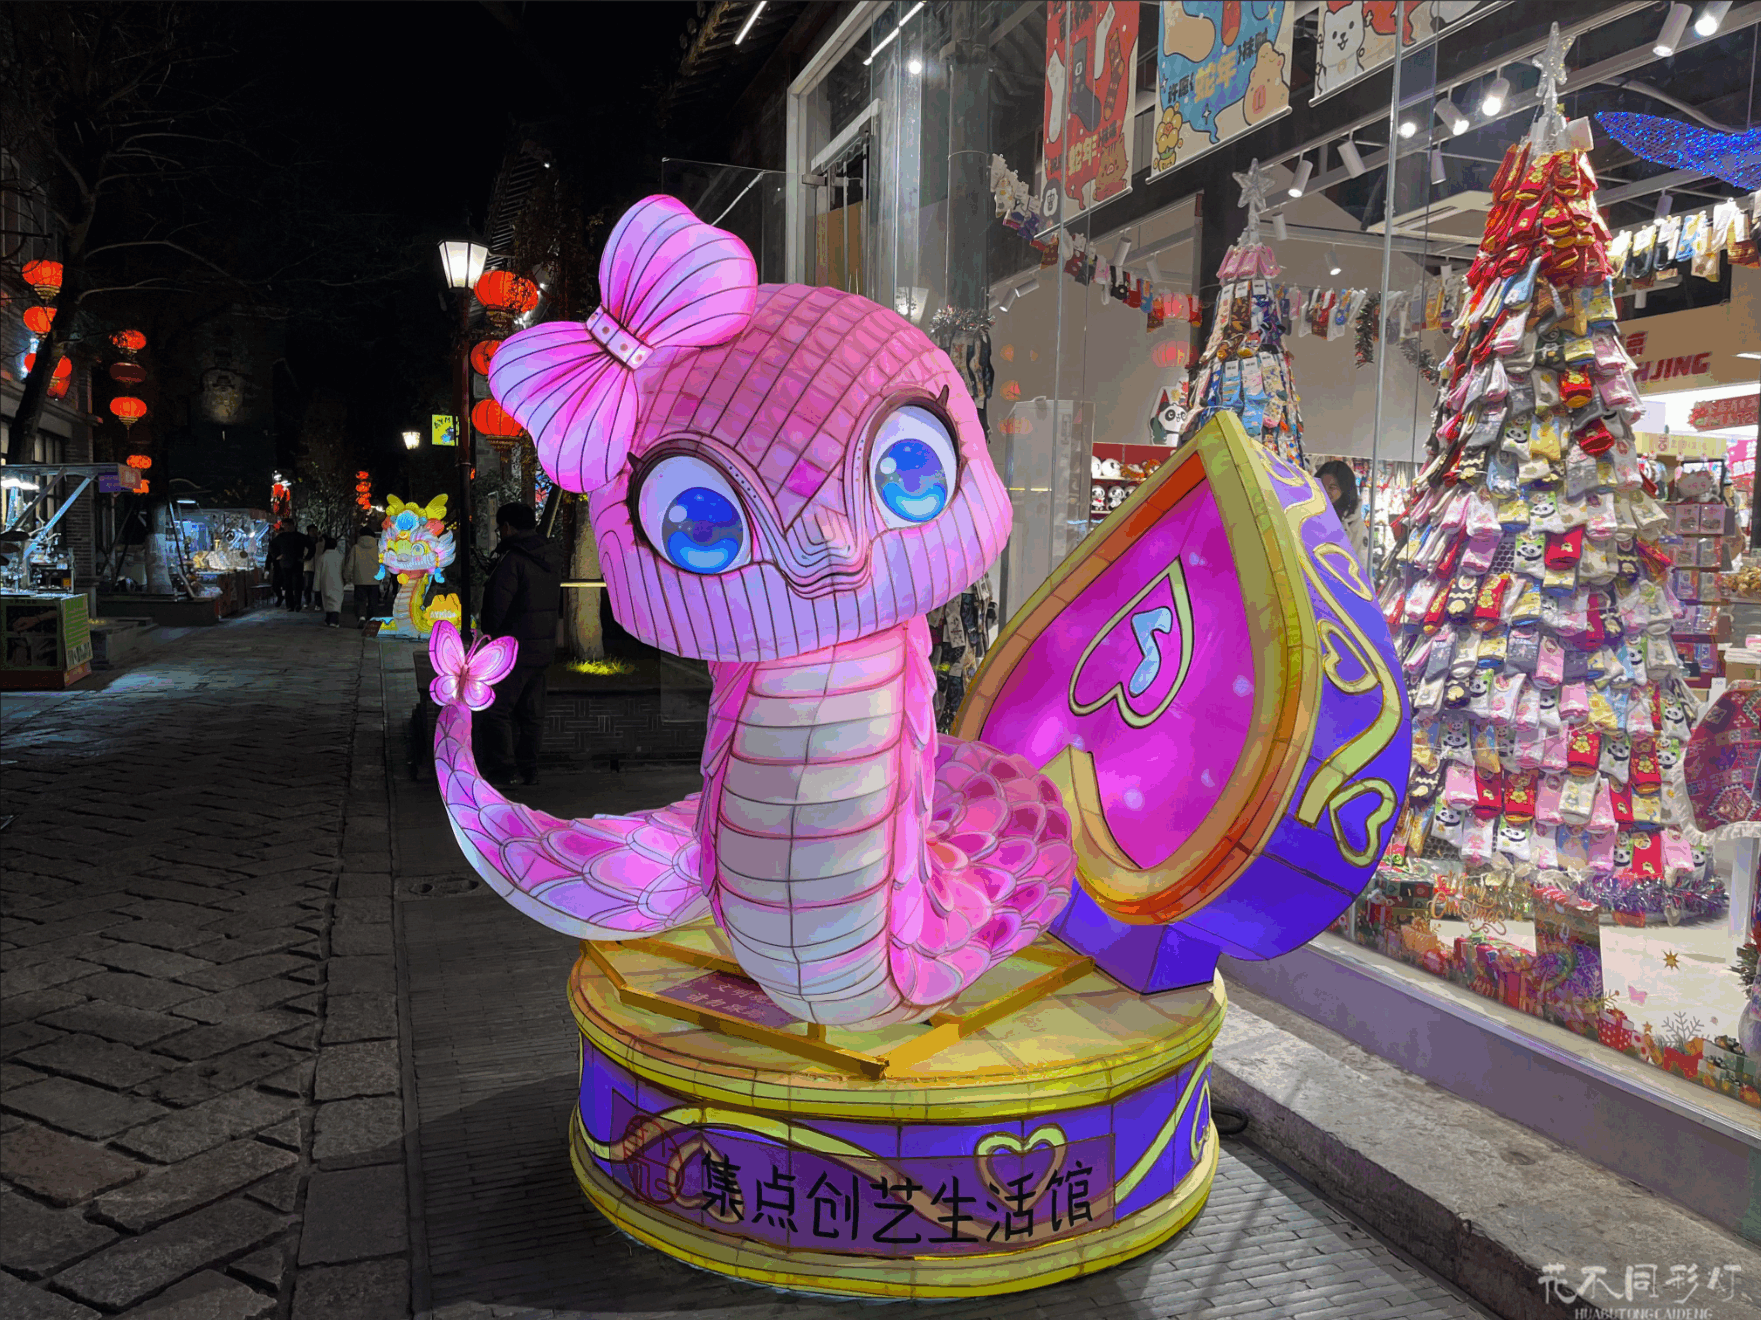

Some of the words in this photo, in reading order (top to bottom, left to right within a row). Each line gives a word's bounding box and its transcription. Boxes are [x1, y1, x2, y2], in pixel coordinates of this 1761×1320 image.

[700, 1149, 1094, 1245] 集点创艺生活馆
